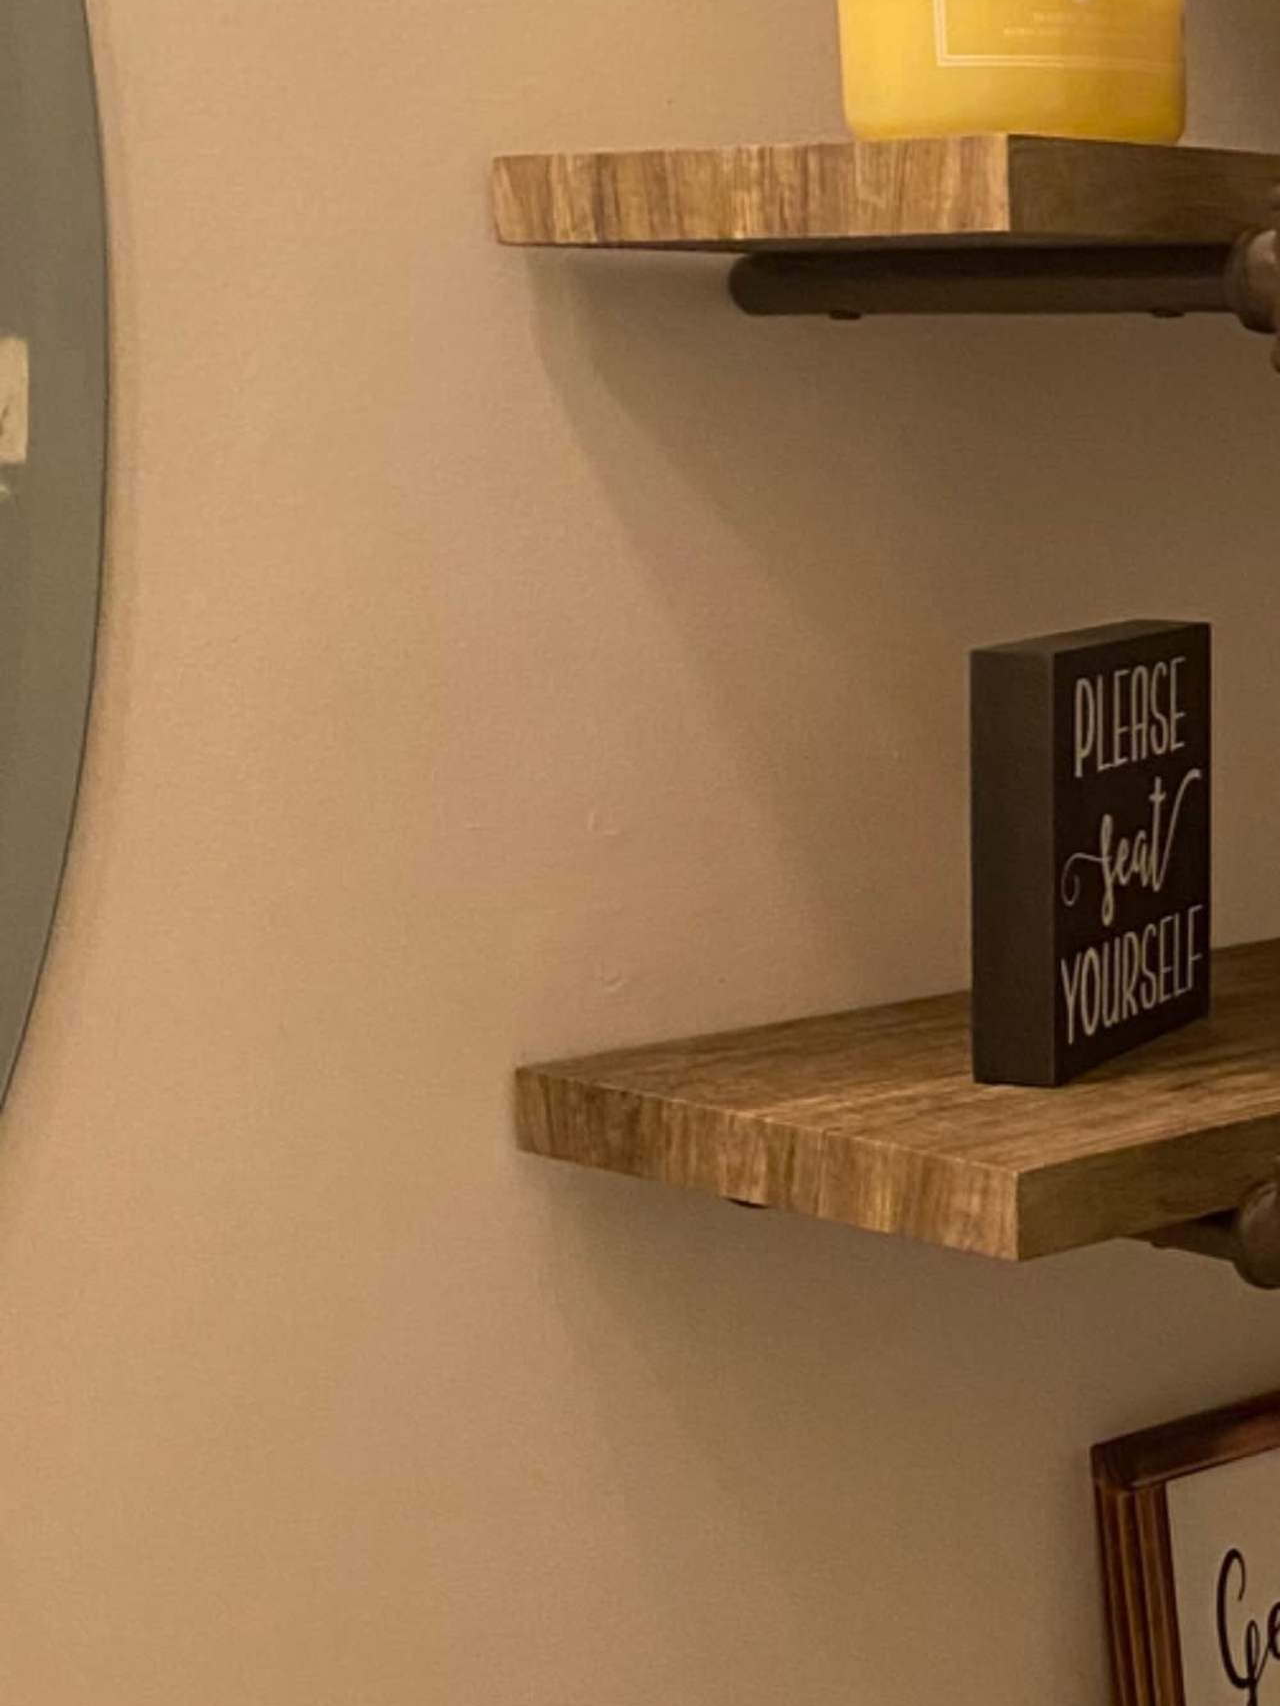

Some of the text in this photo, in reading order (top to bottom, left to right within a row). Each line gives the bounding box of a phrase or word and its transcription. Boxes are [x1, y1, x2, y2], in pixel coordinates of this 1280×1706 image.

[1073, 656, 1187, 779] PLEASE
[1060, 768, 1202, 927] seat
[1060, 903, 1204, 1045] YOURSELF
